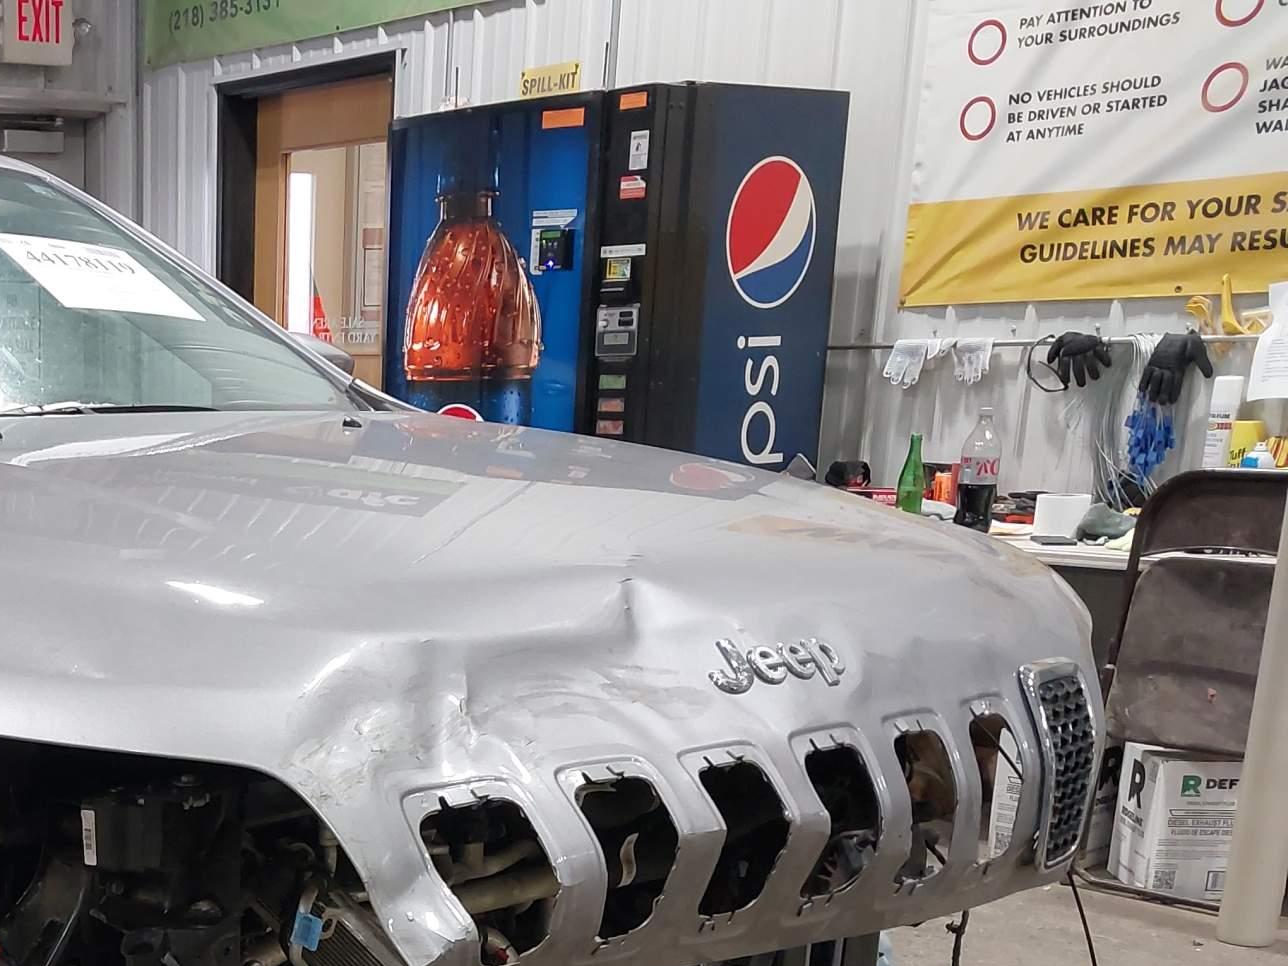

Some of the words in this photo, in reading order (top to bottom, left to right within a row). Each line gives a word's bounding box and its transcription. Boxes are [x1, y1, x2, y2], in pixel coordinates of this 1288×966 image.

[18, 0, 63, 43] EXIT
[169, 4, 203, 34] (218)
[1017, 32, 1053, 48] YOUR
[1059, 11, 1181, 43] SURROUNDINGS
[1019, 14, 1043, 30] PAY
[1046, 1, 1127, 25] ATTENTION
[1132, 0, 1152, 11] TO
[521, 71, 578, 96] SPILL-KIT
[1008, 91, 1033, 106] NO
[1037, 84, 1097, 102] VEHICLES
[1101, 75, 1162, 94] SHOULD
[1007, 111, 1023, 124] BE
[1028, 105, 1077, 122] DRIVEN
[1081, 102, 1101, 116] OR
[1105, 94, 1168, 113] STARTED
[1006, 130, 1022, 143] AT
[1026, 123, 1085, 141] ANYTIME
[1017, 210, 1050, 231] WE
[1057, 205, 1120, 228] CARE
[1127, 201, 1177, 224] FOR
[1187, 194, 1261, 219] YOUR
[1271, 191, 1288, 214] S
[25, 250, 136, 275] 44178119
[1020, 237, 1155, 263] GUIDELINES
[1163, 233, 1223, 256] MAY
[708, 637, 846, 695] Jeep
[1205, 778, 1240, 790] DEF
